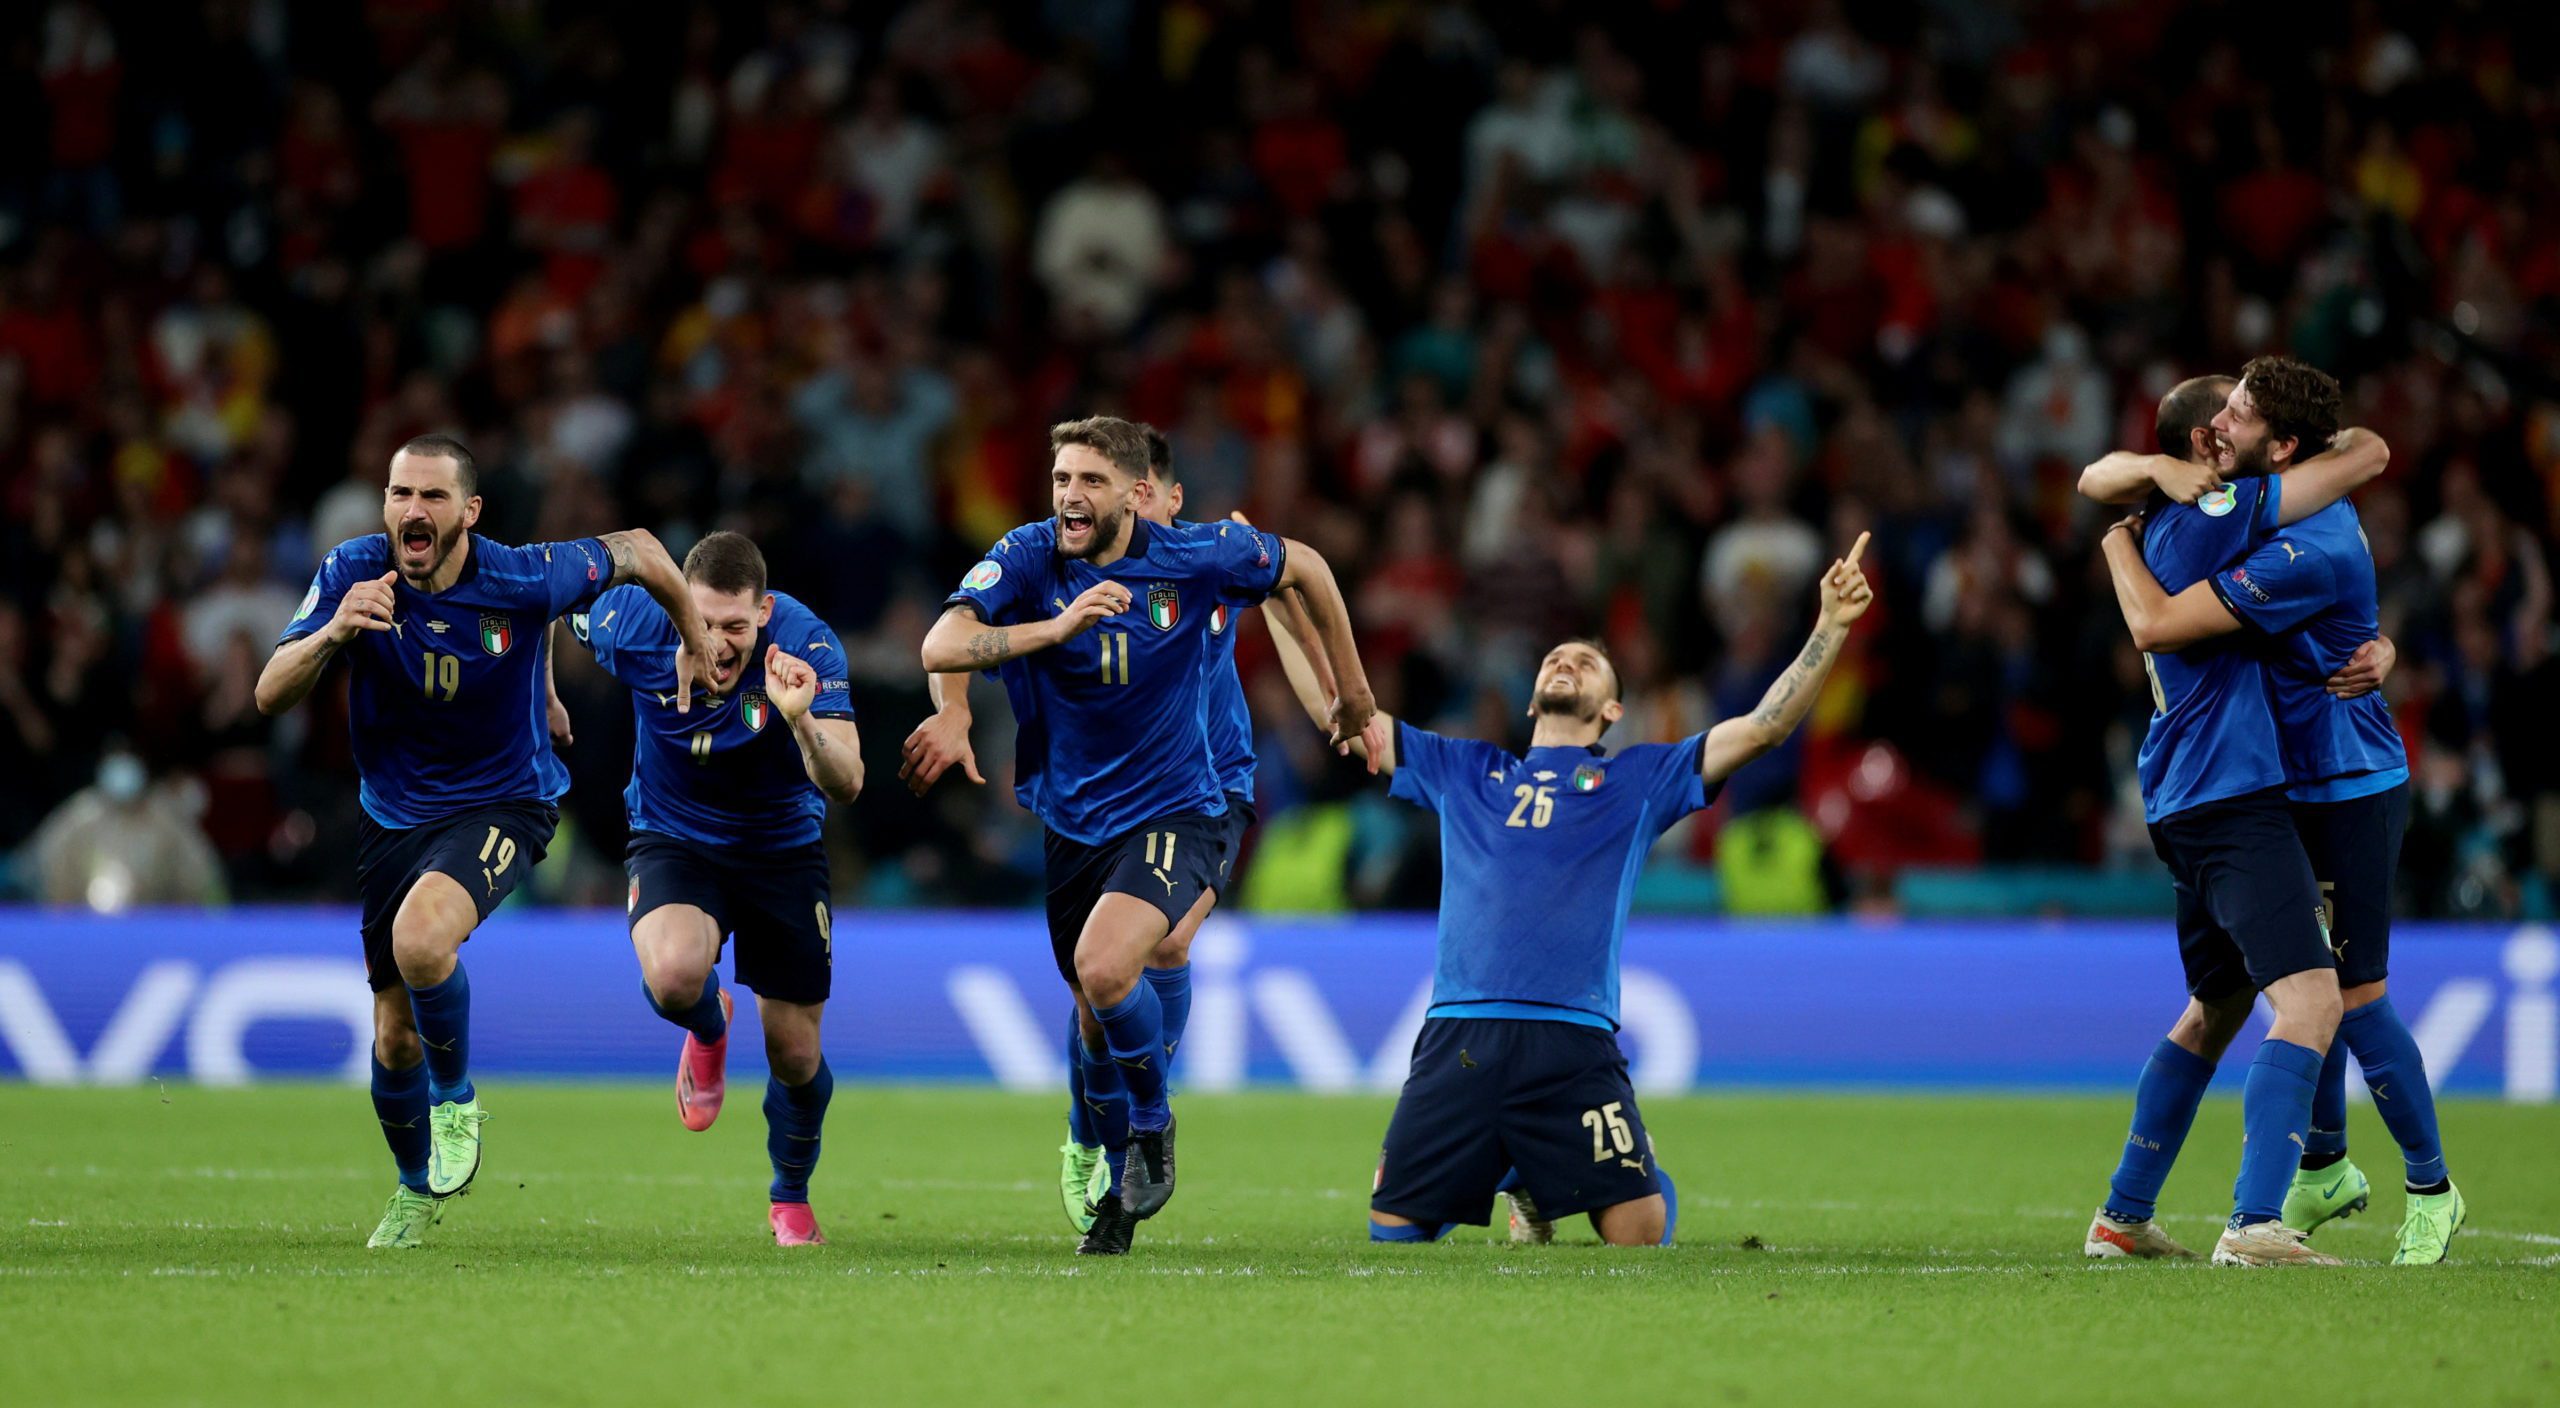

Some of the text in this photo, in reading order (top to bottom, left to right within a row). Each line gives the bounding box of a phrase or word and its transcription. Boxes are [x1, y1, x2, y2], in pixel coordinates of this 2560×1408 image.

[1150, 592, 1175, 600] ITALIA
[2241, 577, 2270, 602] RESPECT
[482, 619, 507, 628] ITALIA
[424, 652, 459, 701] 19
[1099, 632, 1128, 684] 11
[1505, 784, 1554, 828] 25
[479, 826, 516, 876] 19
[1145, 832, 1176, 872] 11
[815, 901, 830, 953] 9
[1582, 1101, 1634, 1163] 25
